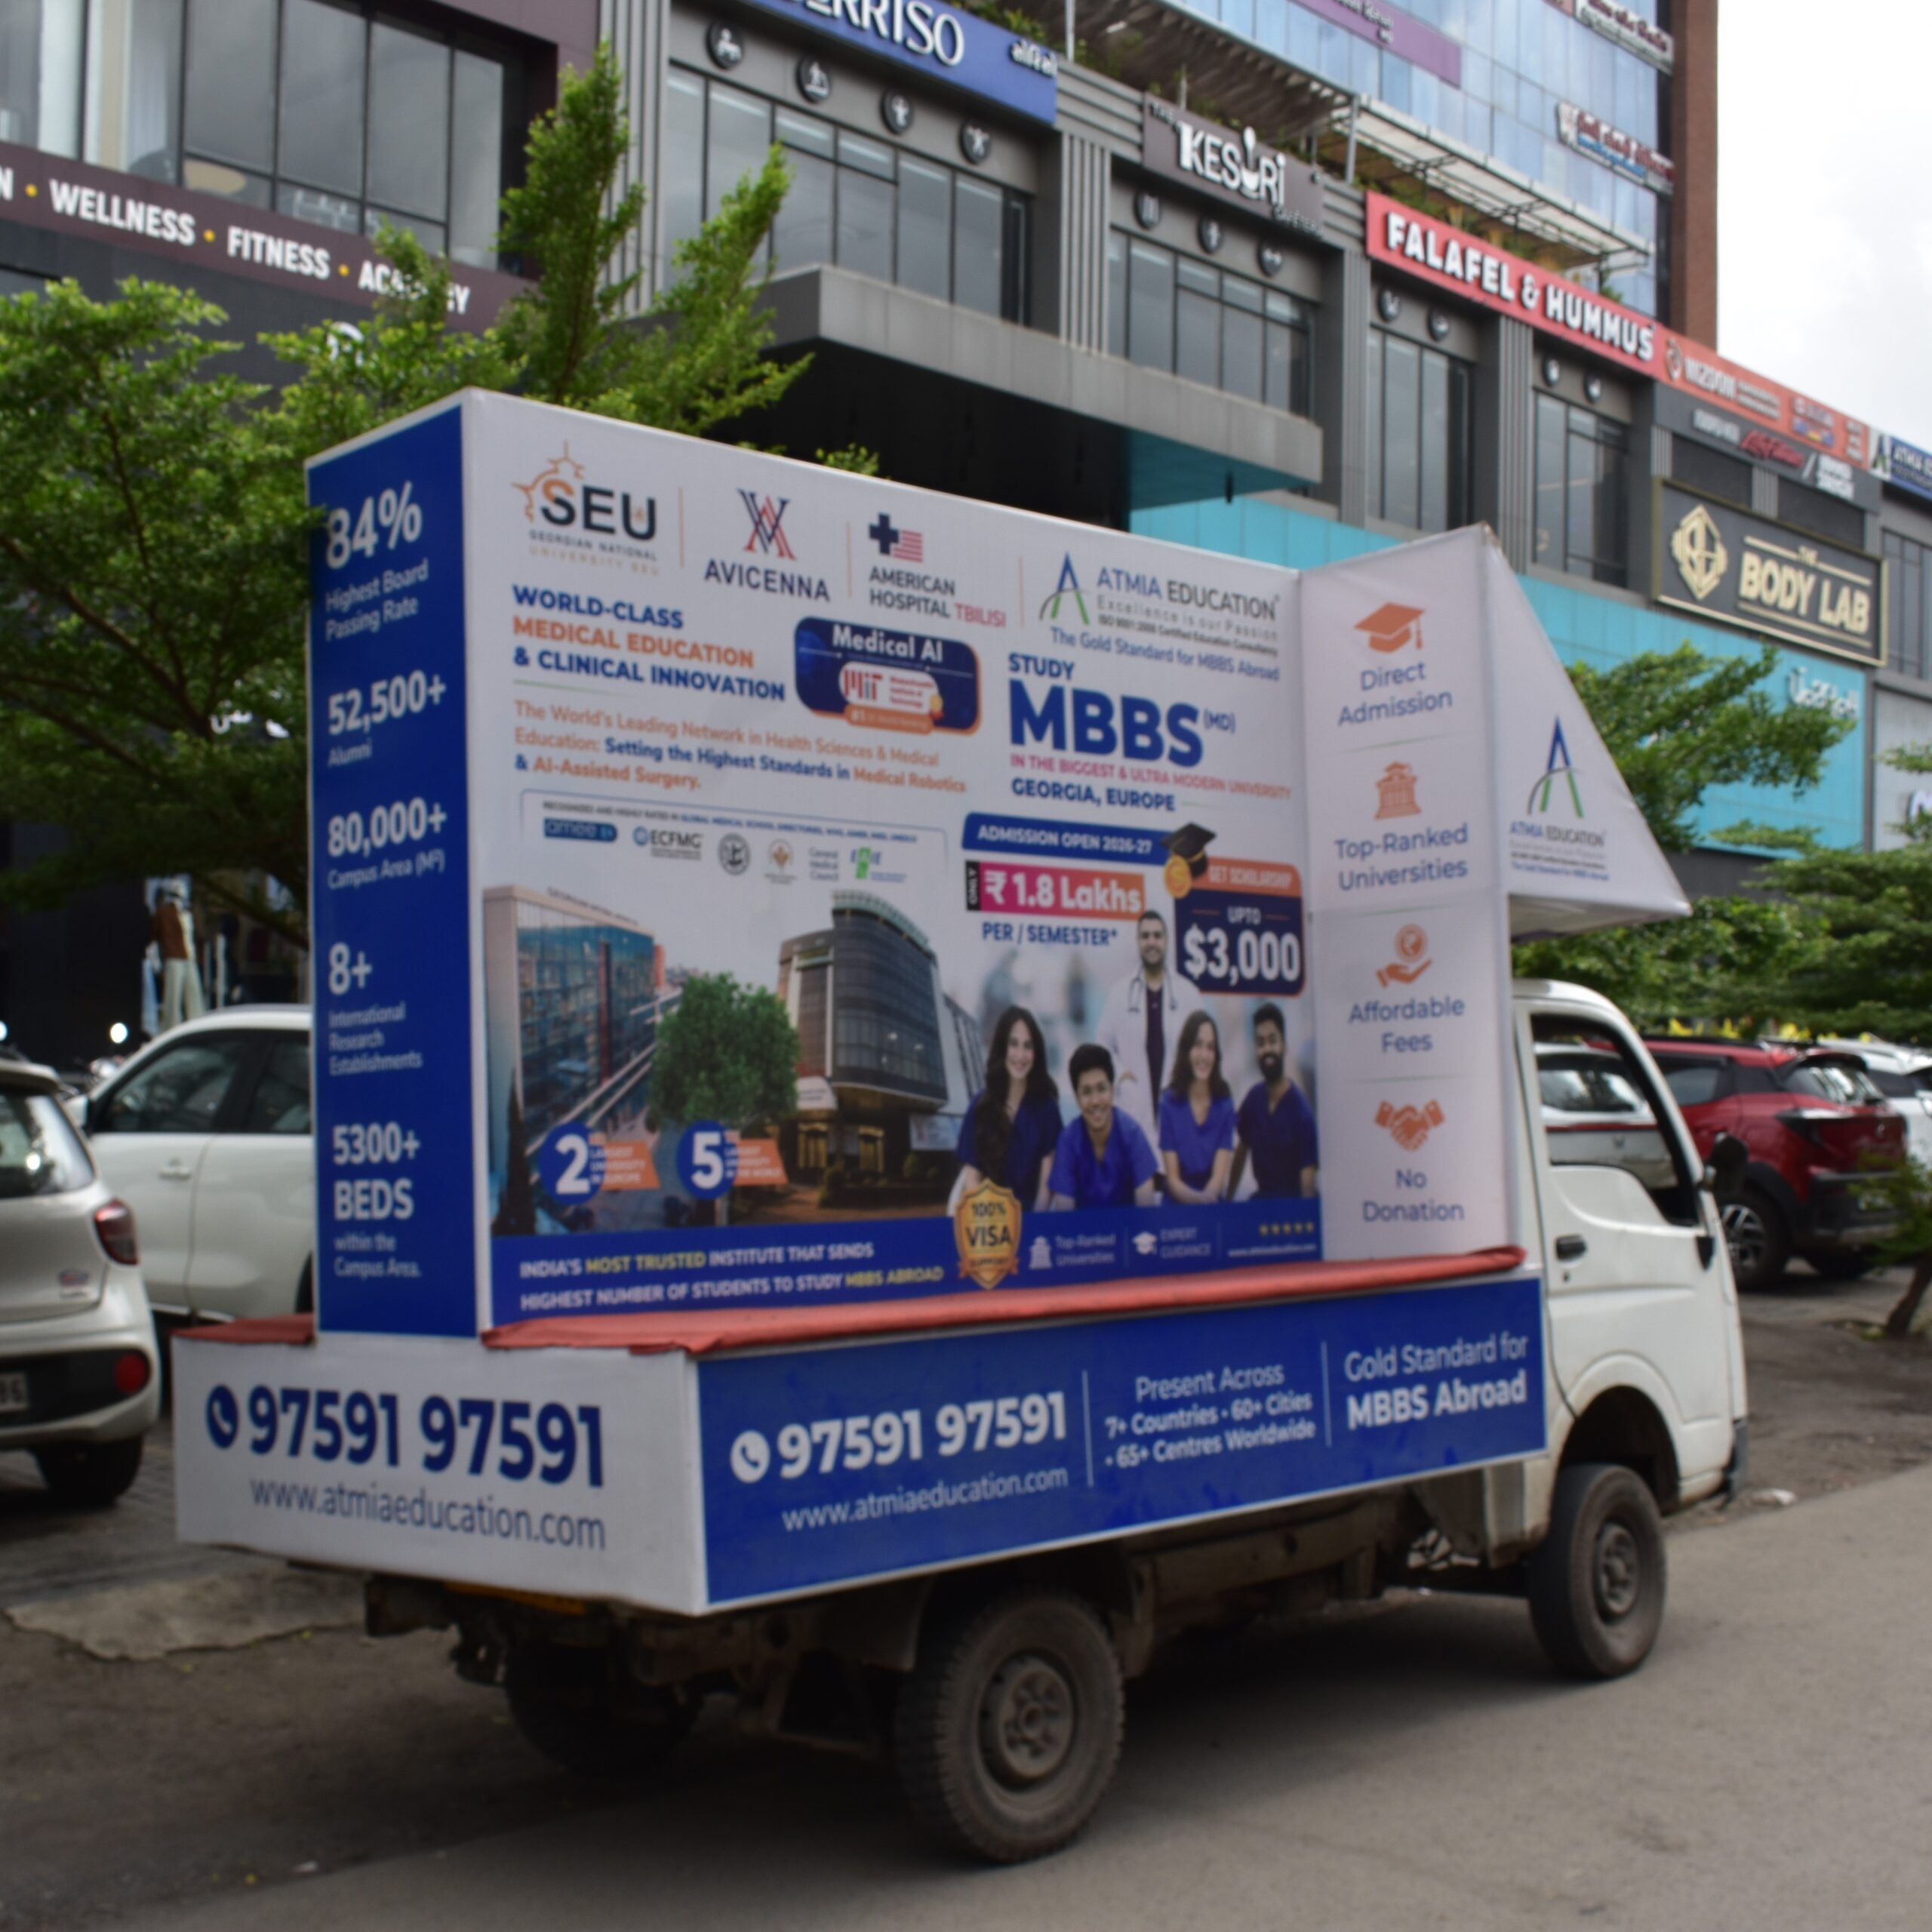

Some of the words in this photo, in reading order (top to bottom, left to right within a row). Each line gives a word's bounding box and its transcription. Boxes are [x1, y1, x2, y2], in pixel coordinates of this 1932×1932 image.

[50, 179, 195, 246] WELLNESS
[228, 226, 331, 280] FITNESS
[358, 260, 470, 315] ACAY
[1386, 211, 1515, 303] FALAFEL
[1521, 272, 1541, 311] &
[1546, 285, 1654, 361] HUMMUS
[327, 480, 423, 569] 84%
[540, 478, 657, 542] SEU
[529, 529, 592, 550] GEORGIAN
[599, 540, 657, 562] NATIONAL
[325, 577, 380, 612] Highest
[383, 558, 429, 594] Board
[704, 558, 831, 601] AVICENNA
[869, 565, 955, 596] AMERICAN
[1097, 566, 1162, 599] ATMIA
[1168, 580, 1275, 621] EDUCATION
[1740, 552, 1816, 617] BODY
[1819, 580, 1870, 635] LAB
[326, 608, 380, 641] Passing
[383, 596, 419, 623] Rate
[512, 584, 684, 629] WORLD-CLASS
[869, 589, 951, 619] HOSPITAL
[953, 602, 1006, 629] TBILISI
[1097, 594, 1179, 622] Excellence
[512, 616, 620, 650] MEDICAL
[627, 633, 754, 669] EDUCATION
[832, 624, 915, 658] Medical
[921, 639, 943, 663] AI
[1051, 626, 1075, 647] The
[1080, 631, 1112, 653] Gold
[1115, 637, 1173, 663] Standard
[1177, 651, 1194, 667] for
[1198, 654, 1235, 674] MBBS
[1237, 659, 1280, 681] Abroad
[513, 647, 529, 667] &
[537, 650, 644, 682] CLINICAL
[651, 664, 786, 703] INNOVATION
[1008, 653, 1075, 680] STUDY
[1360, 661, 1426, 691] Direct
[328, 669, 447, 736] 52,500+
[1009, 678, 1202, 768] MBBS
[1204, 709, 1236, 734] (MD)
[1337, 690, 1453, 727] Admission
[515, 699, 546, 720] The
[550, 704, 613, 728] World's
[617, 713, 678, 739] Leading
[681, 721, 744, 743] Network
[749, 731, 762, 746] in
[766, 732, 812, 752] Health
[816, 737, 873, 760] Sciences
[890, 746, 940, 768] Medical
[515, 754, 528, 771] &
[534, 755, 631, 783] AI-Assisted
[605, 737, 663, 763] Setting
[668, 742, 693, 761] the
[697, 747, 755, 769] Highest
[760, 755, 833, 778] Standards
[837, 763, 850, 780] in
[853, 765, 906, 787] Medical
[909, 772, 968, 793] Robotics
[1011, 754, 1026, 768] IN
[1029, 755, 1056, 773] THE
[1059, 759, 1115, 779] BIGGEST
[1132, 766, 1170, 785] ULTRA
[1173, 773, 1226, 791] MODERN
[1229, 779, 1292, 800] UNIVERSITY
[1011, 777, 1102, 807] GEORGIA,
[1106, 787, 1175, 811] EUROPE
[328, 797, 447, 857] 80,000+
[651, 829, 702, 850] ECFMG
[977, 825, 1059, 846] ADMISSION
[1061, 832, 1100, 850] OPEN
[1334, 822, 1468, 861] Top-Ranked
[328, 865, 377, 890] Campus
[380, 857, 412, 880] Area
[1060, 876, 1143, 913] Lakhs
[1339, 858, 1469, 891] Universities
[983, 921, 1014, 942] PER
[1227, 906, 1261, 925] UPTO
[328, 942, 373, 995] 8+
[1183, 923, 1300, 986] $3,000
[329, 1001, 405, 1029] International
[1349, 995, 1465, 1024] Affordable
[1381, 1032, 1433, 1054] Fees
[332, 1121, 420, 1165] 5300+
[555, 1134, 590, 1195] 2
[691, 1132, 724, 1189] 5
[334, 1178, 414, 1220] BEDS
[1395, 1168, 1427, 1189] No
[973, 1201, 1006, 1217] 100%
[1362, 1200, 1464, 1223] Donation
[965, 1225, 1011, 1247] VISA
[334, 1256, 383, 1281] Campus
[520, 1258, 582, 1278] INDIA'S
[585, 1254, 631, 1274] MOST
[635, 1251, 707, 1272] TRUSTED
[709, 1247, 785, 1267] INSTITUTE
[788, 1244, 826, 1262] THAT
[827, 1241, 875, 1260] SENDS
[521, 1288, 593, 1311] HIGHEST
[596, 1284, 664, 1306] NUMBER
[667, 1281, 689, 1300] OF
[691, 1277, 770, 1299] STUDENTS
[773, 1275, 792, 1293] TO
[795, 1273, 843, 1292] STUDY
[886, 1266, 945, 1284] ABROAD
[1344, 1345, 1396, 1382] Gold
[1401, 1332, 1497, 1374] Standard
[1500, 1331, 1528, 1360] for
[1136, 1370, 1216, 1403] Present
[1219, 1364, 1284, 1392] Across
[1347, 1384, 1429, 1430] MBBS
[1434, 1368, 1527, 1417] Abroad
[1131, 1402, 1219, 1435] Countries
[1265, 1389, 1313, 1416] Cities
[247, 1384, 399, 1467] 97591
[419, 1394, 605, 1488] 97591
[777, 1407, 923, 1480] 97591
[936, 1390, 1066, 1457] 97591
[1152, 1435, 1223, 1463] Centres
[1225, 1417, 1316, 1451] Worldwide
[250, 1477, 606, 1550] www.atmiaeducation.com
[781, 1466, 1069, 1533] www.atmiaeducation.com
